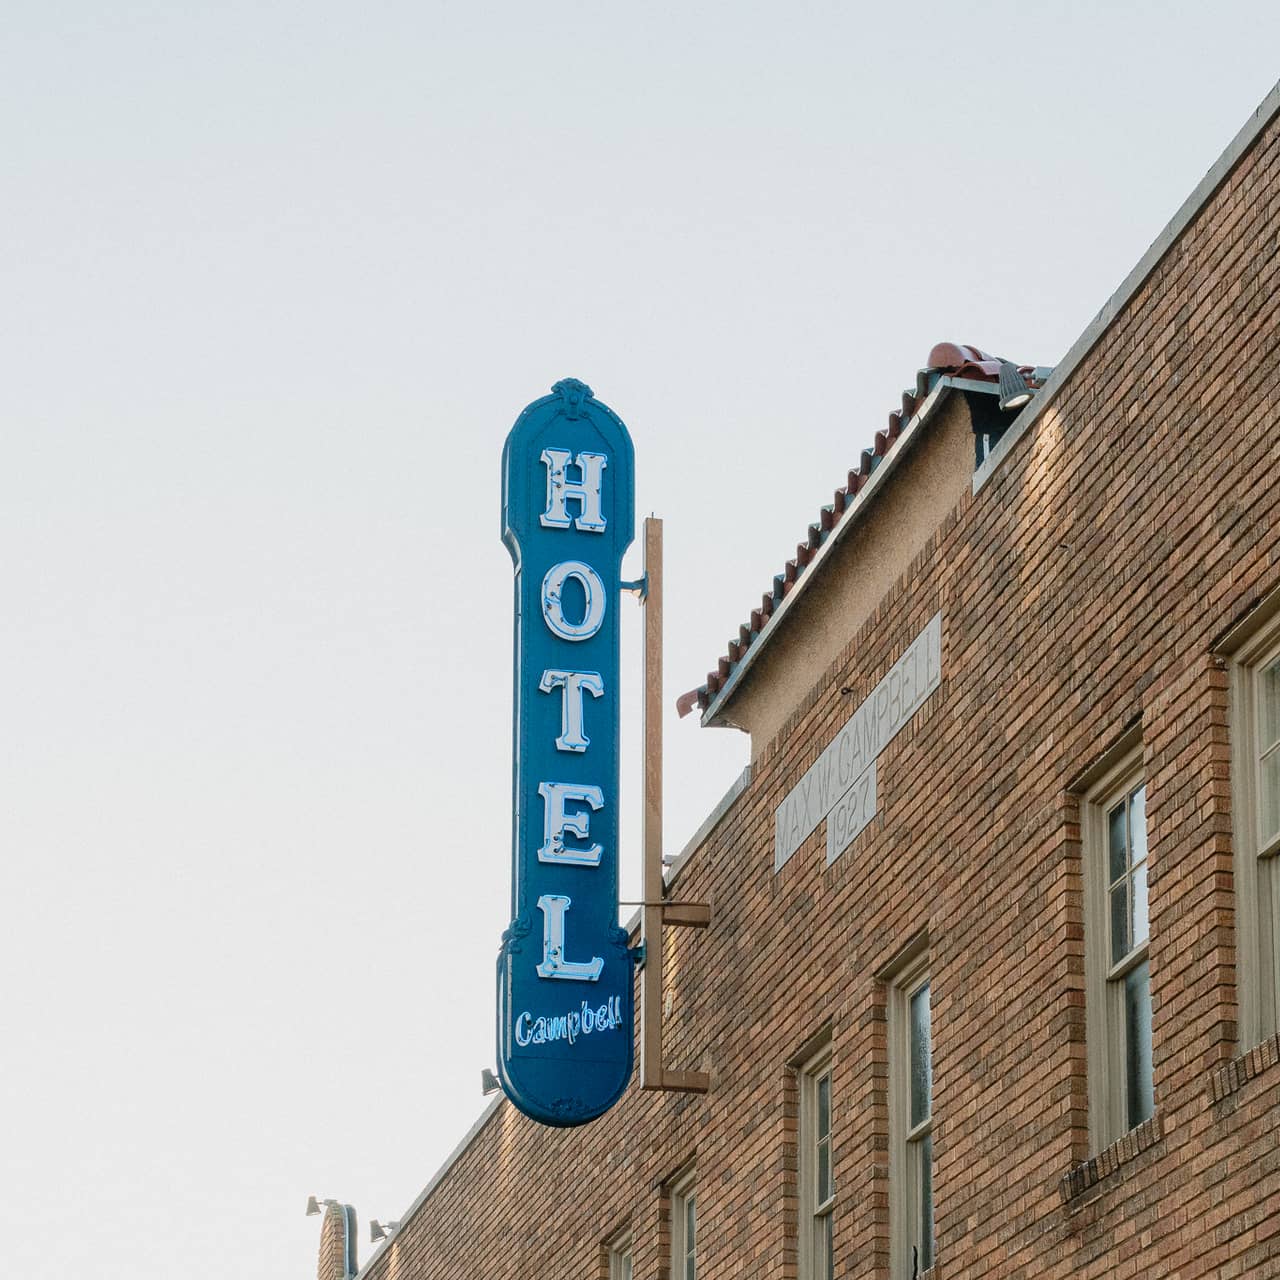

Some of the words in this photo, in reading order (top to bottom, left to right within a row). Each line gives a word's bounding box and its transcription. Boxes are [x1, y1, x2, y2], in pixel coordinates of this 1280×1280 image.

[537, 446, 608, 981] HOTEL
[776, 779, 814, 859] MAX
[839, 632, 939, 786] CAMPBELL
[831, 777, 870, 856] 1927
[514, 996, 622, 1047] Campbell
